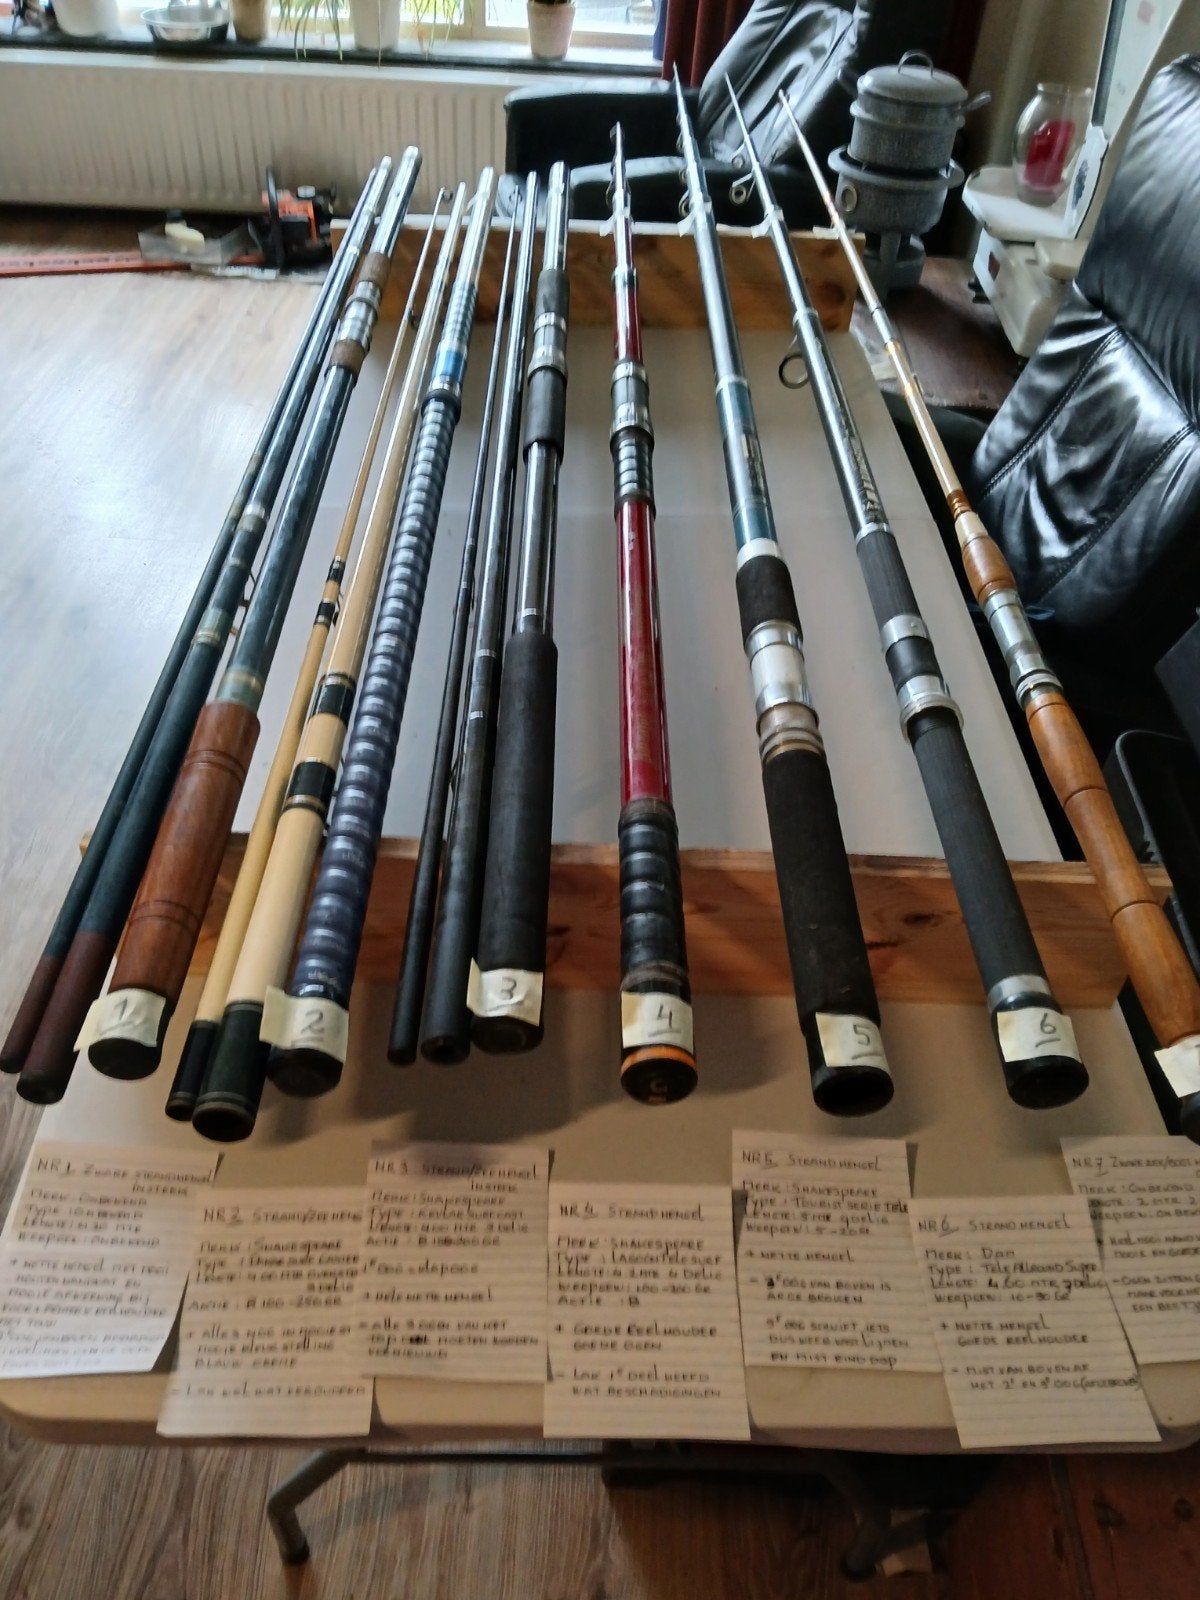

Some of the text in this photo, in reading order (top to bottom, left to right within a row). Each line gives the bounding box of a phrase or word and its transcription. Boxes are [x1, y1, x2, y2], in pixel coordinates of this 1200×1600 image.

[498, 980, 517, 1001] 3
[302, 1009, 325, 1035] 2
[656, 1003, 674, 1028] 4
[1039, 1012, 1057, 1035] 6
[852, 1024, 872, 1046] 5
